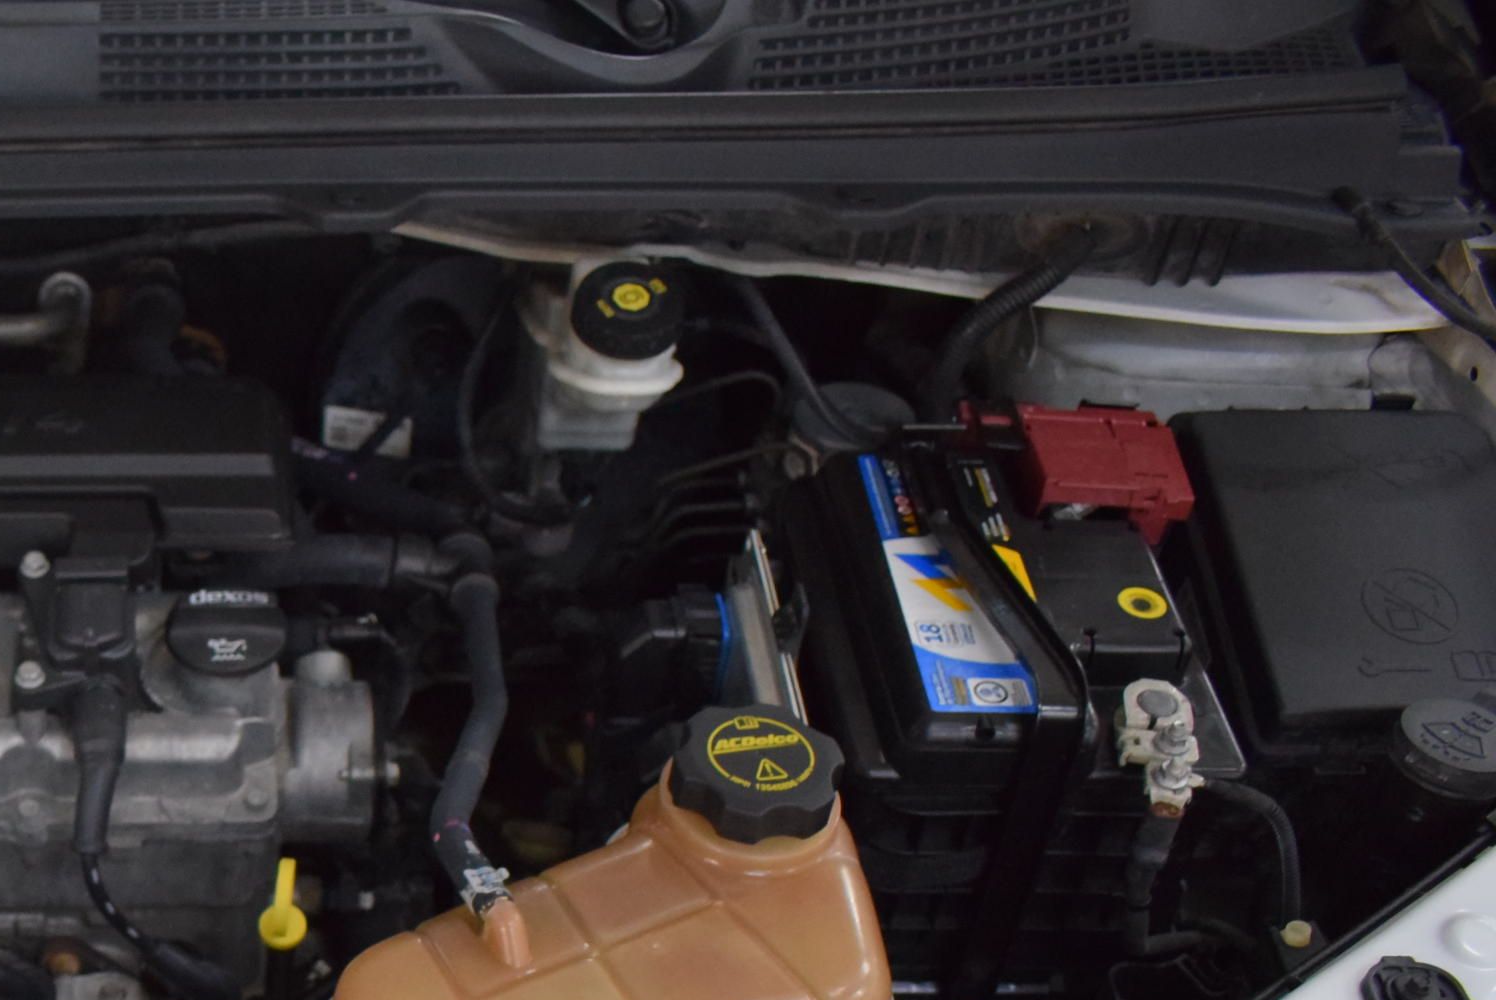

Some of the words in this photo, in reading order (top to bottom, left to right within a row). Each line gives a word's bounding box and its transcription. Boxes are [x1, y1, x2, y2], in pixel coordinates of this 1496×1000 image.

[189, 588, 268, 604] dexos
[918, 623, 943, 643] 18
[714, 734, 799, 751] ACDelco
